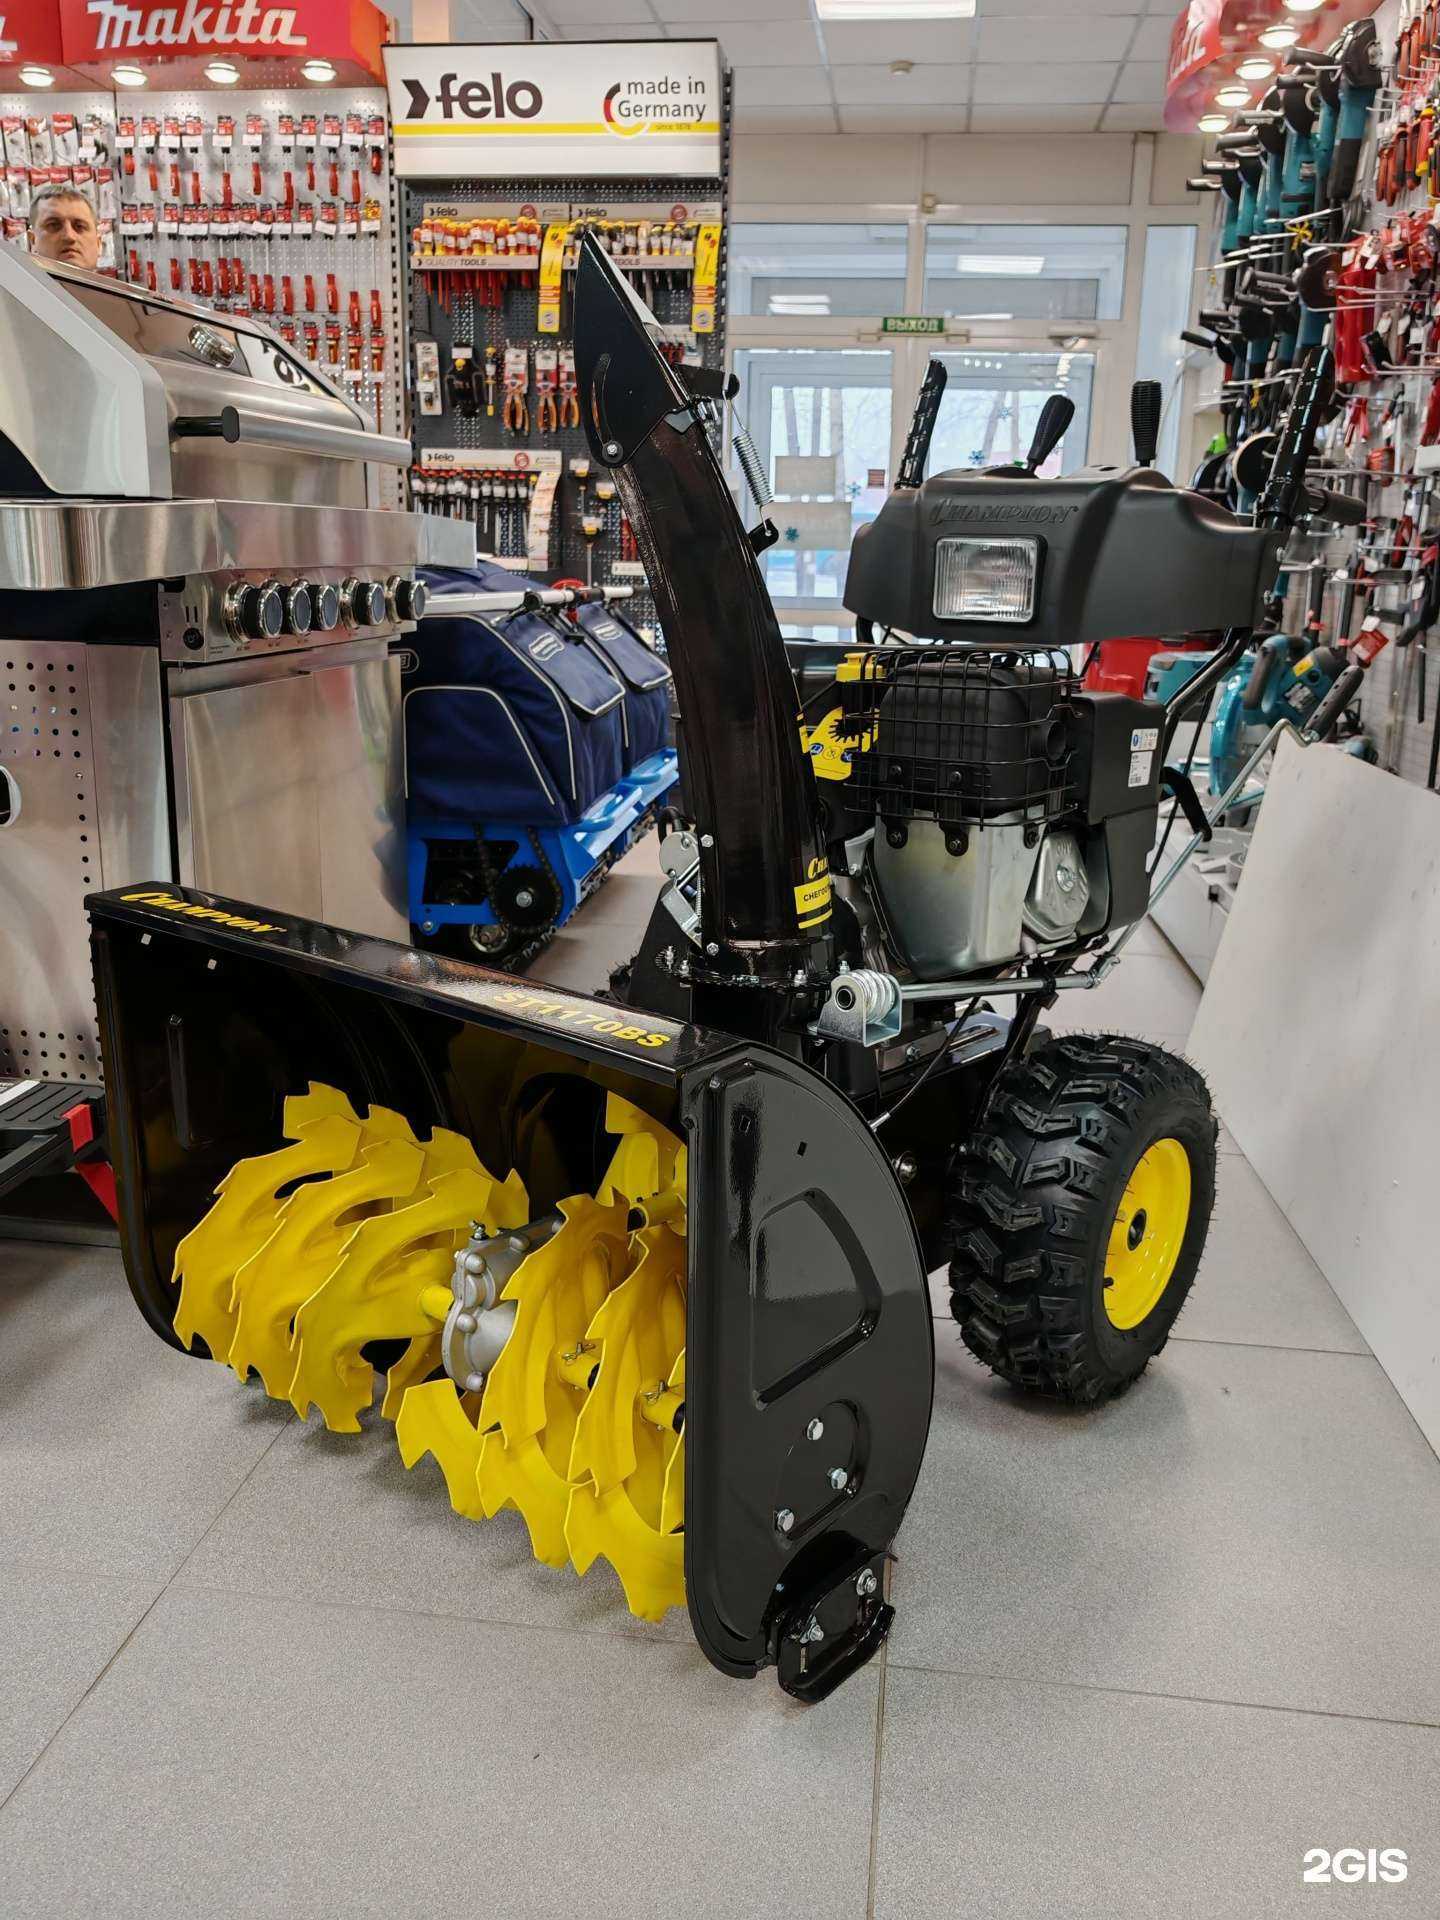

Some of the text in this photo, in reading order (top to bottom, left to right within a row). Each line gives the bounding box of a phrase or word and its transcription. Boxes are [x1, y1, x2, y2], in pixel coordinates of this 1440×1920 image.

[87, 0, 308, 49] Makita
[627, 76, 706, 94] made in
[436, 72, 543, 119] felo
[618, 100, 707, 122] Germany
[435, 206, 459, 217] felo
[584, 207, 608, 218] felo
[460, 257, 487, 266] TOOLS
[887, 318, 940, 332] ВЫХОД
[433, 452, 455, 462] felo
[928, 498, 1080, 526] CHAMPION
[119, 892, 288, 933] CHAMPION
[493, 990, 672, 1048] ST1170BS
